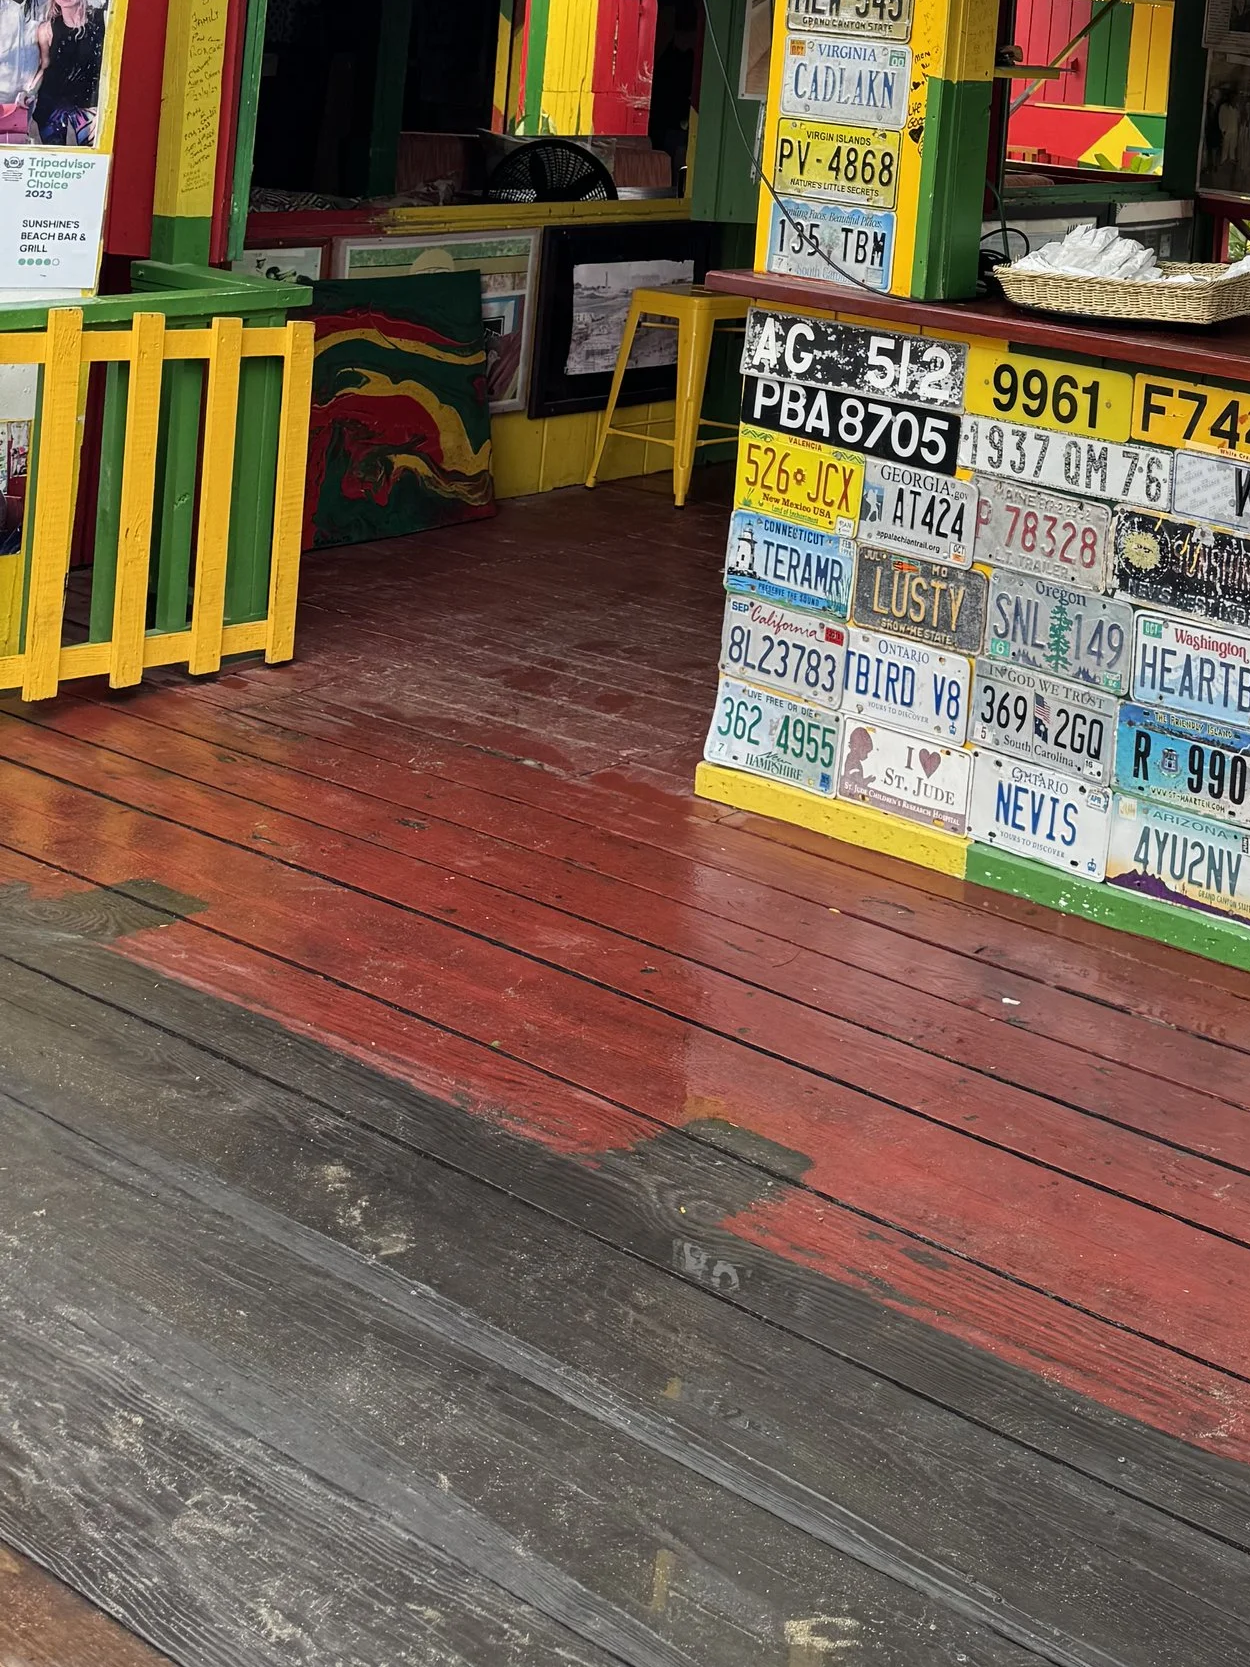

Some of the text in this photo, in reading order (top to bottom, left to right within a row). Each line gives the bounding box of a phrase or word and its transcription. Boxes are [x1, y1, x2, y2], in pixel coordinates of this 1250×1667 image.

[817, 44, 877, 62] VIRGINIA
[806, 130, 871, 146] VIRGIN ISLANDS
[27, 166, 86, 181] Travelers'
[28, 156, 96, 171] Tripadvisor
[24, 189, 53, 201] 2023
[26, 179, 69, 191] Choice
[20, 231, 87, 242] BEACH BAR &
[22, 218, 80, 230] SUNSHINE'S
[19, 243, 48, 254] GRILL
[993, 362, 1101, 430] 9961
[753, 380, 949, 466] PBA 8705
[787, 435, 823, 450] VALENCIA
[762, 492, 832, 521] New Mexico USA
[763, 519, 826, 547] CONNECTICUT
[876, 530, 941, 555] appalachiantrail.org
[1005, 504, 1099, 571] 78328
[762, 538, 843, 598] TERAMR
[873, 567, 967, 633] LUSTY
[1035, 580, 1087, 608] Oregon
[729, 625, 838, 694] 8L23783
[747, 689, 815, 720] LIVE FREE OR DIE
[905, 746, 913, 771] I
[994, 780, 1079, 848] NEVIS
[1152, 811, 1229, 839] ARIZONA
